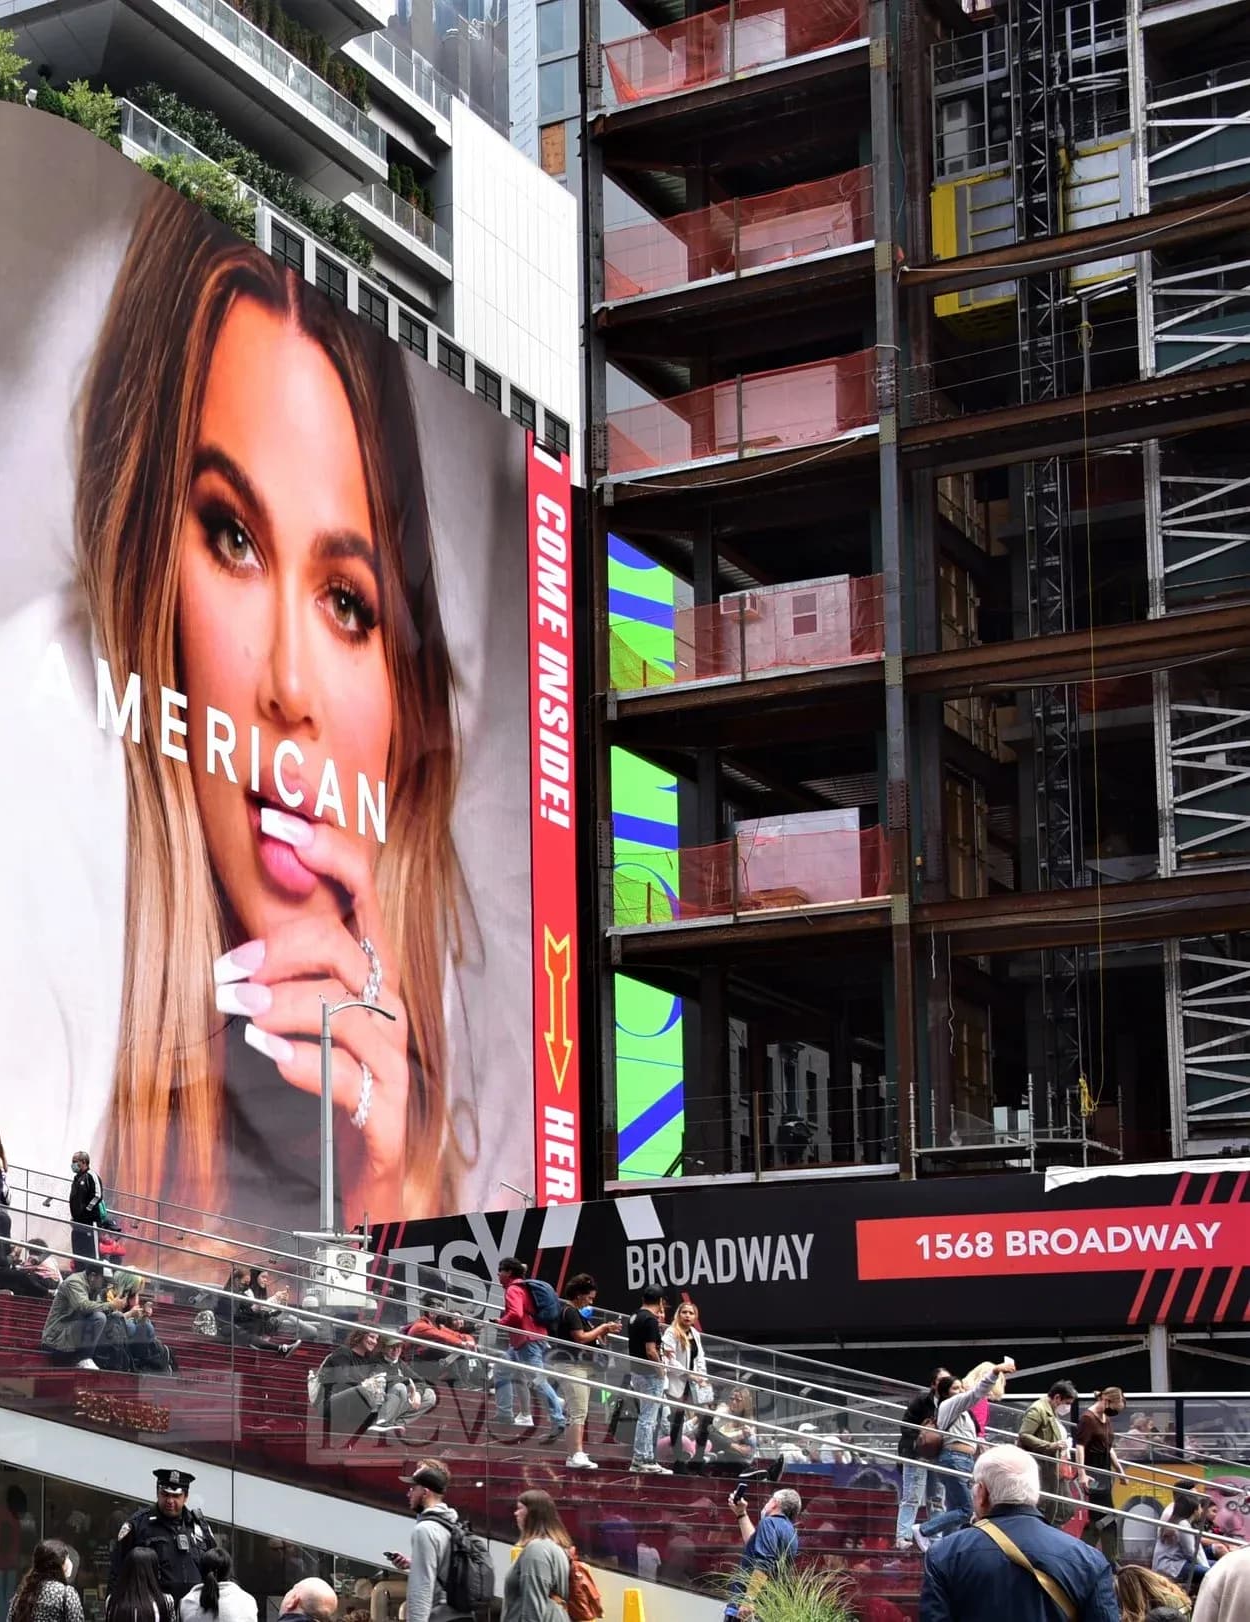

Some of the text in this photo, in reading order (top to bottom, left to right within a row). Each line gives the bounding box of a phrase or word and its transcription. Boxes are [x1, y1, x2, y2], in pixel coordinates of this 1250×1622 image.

[535, 492, 568, 639] COME
[29, 642, 389, 845] AMERICAN
[537, 644, 573, 830] INSIDE!
[544, 1105, 576, 1207] HER
[626, 1233, 815, 1291] BROADWAY
[915, 1222, 1222, 1261] 1568 BROADWAY
